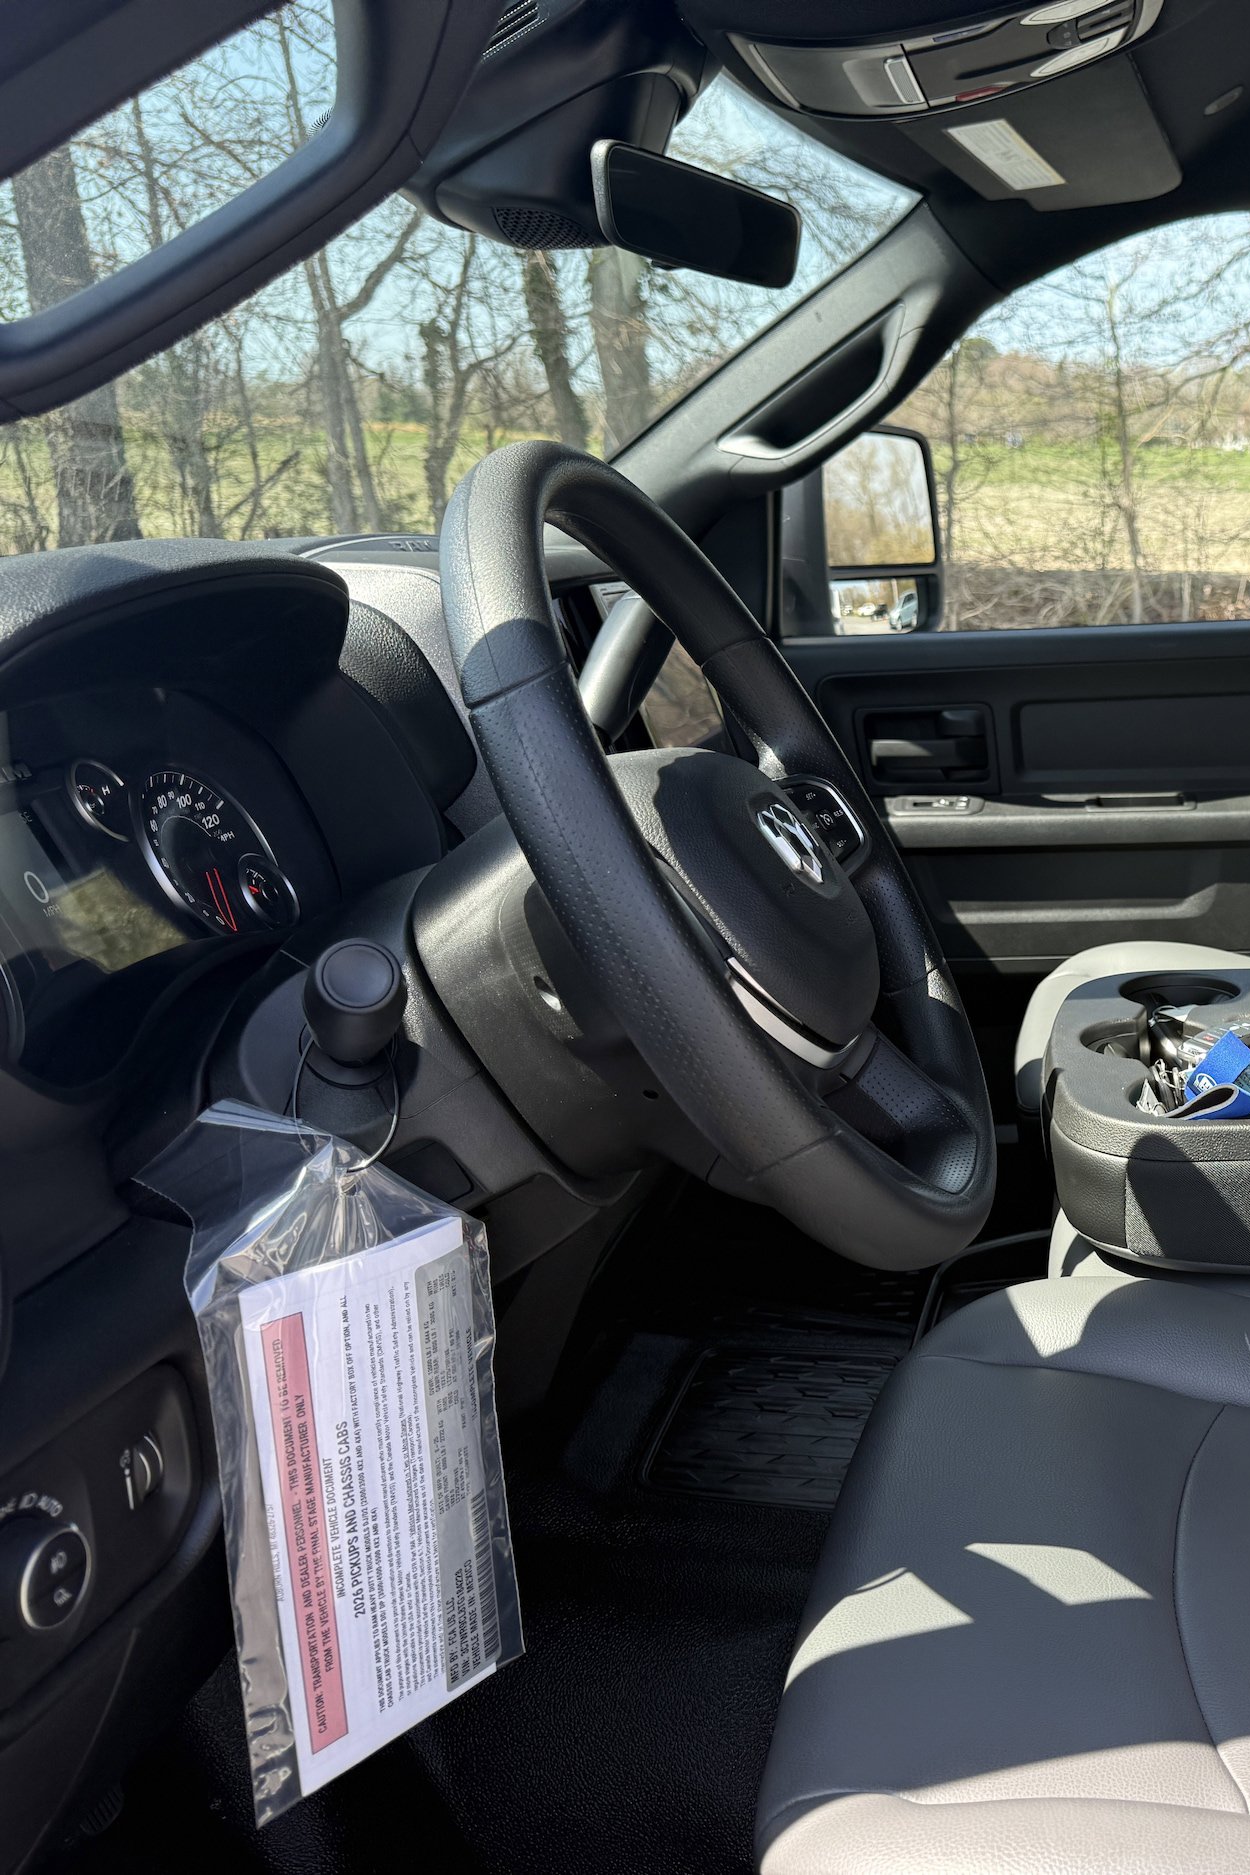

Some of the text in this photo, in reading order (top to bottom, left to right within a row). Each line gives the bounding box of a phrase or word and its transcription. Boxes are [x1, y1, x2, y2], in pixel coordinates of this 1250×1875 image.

[101, 785, 111, 796] H
[157, 794, 168, 809] 80
[176, 793, 192, 809] 100
[194, 801, 206, 811] 110
[201, 813, 220, 829] 120
[24, 871, 49, 904] 0
[271, 1335, 287, 1385] REMOVED
[277, 1382, 288, 1399] BE
[278, 1396, 290, 1413] TO
[280, 1413, 297, 1468] DOCUMENT
[287, 1466, 299, 1491] THIS
[291, 1498, 306, 1554] PERSONNEL
[293, 1390, 334, 1673] FROM THE VEHICLE BY THE FINAL STAGE MANUFACTURER ONLY
[322, 1453, 346, 1600] INCOMPLETE VEHICLE DOCUMENT
[335, 1418, 365, 1620] 2026 PICKUPS AND CHASSIS CABS
[297, 1552, 310, 1589] DEALER
[301, 1588, 313, 1611] AND
[463, 1556, 481, 1670] VEHICLE MADE IN: MEXICO
[304, 1610, 322, 1692] TRANSPORTATION
[445, 1595, 459, 1684] MFD BY: FCA US LLC
[461, 1655, 470, 1677] VIN:
[314, 1690, 327, 1735] CAUTION:
